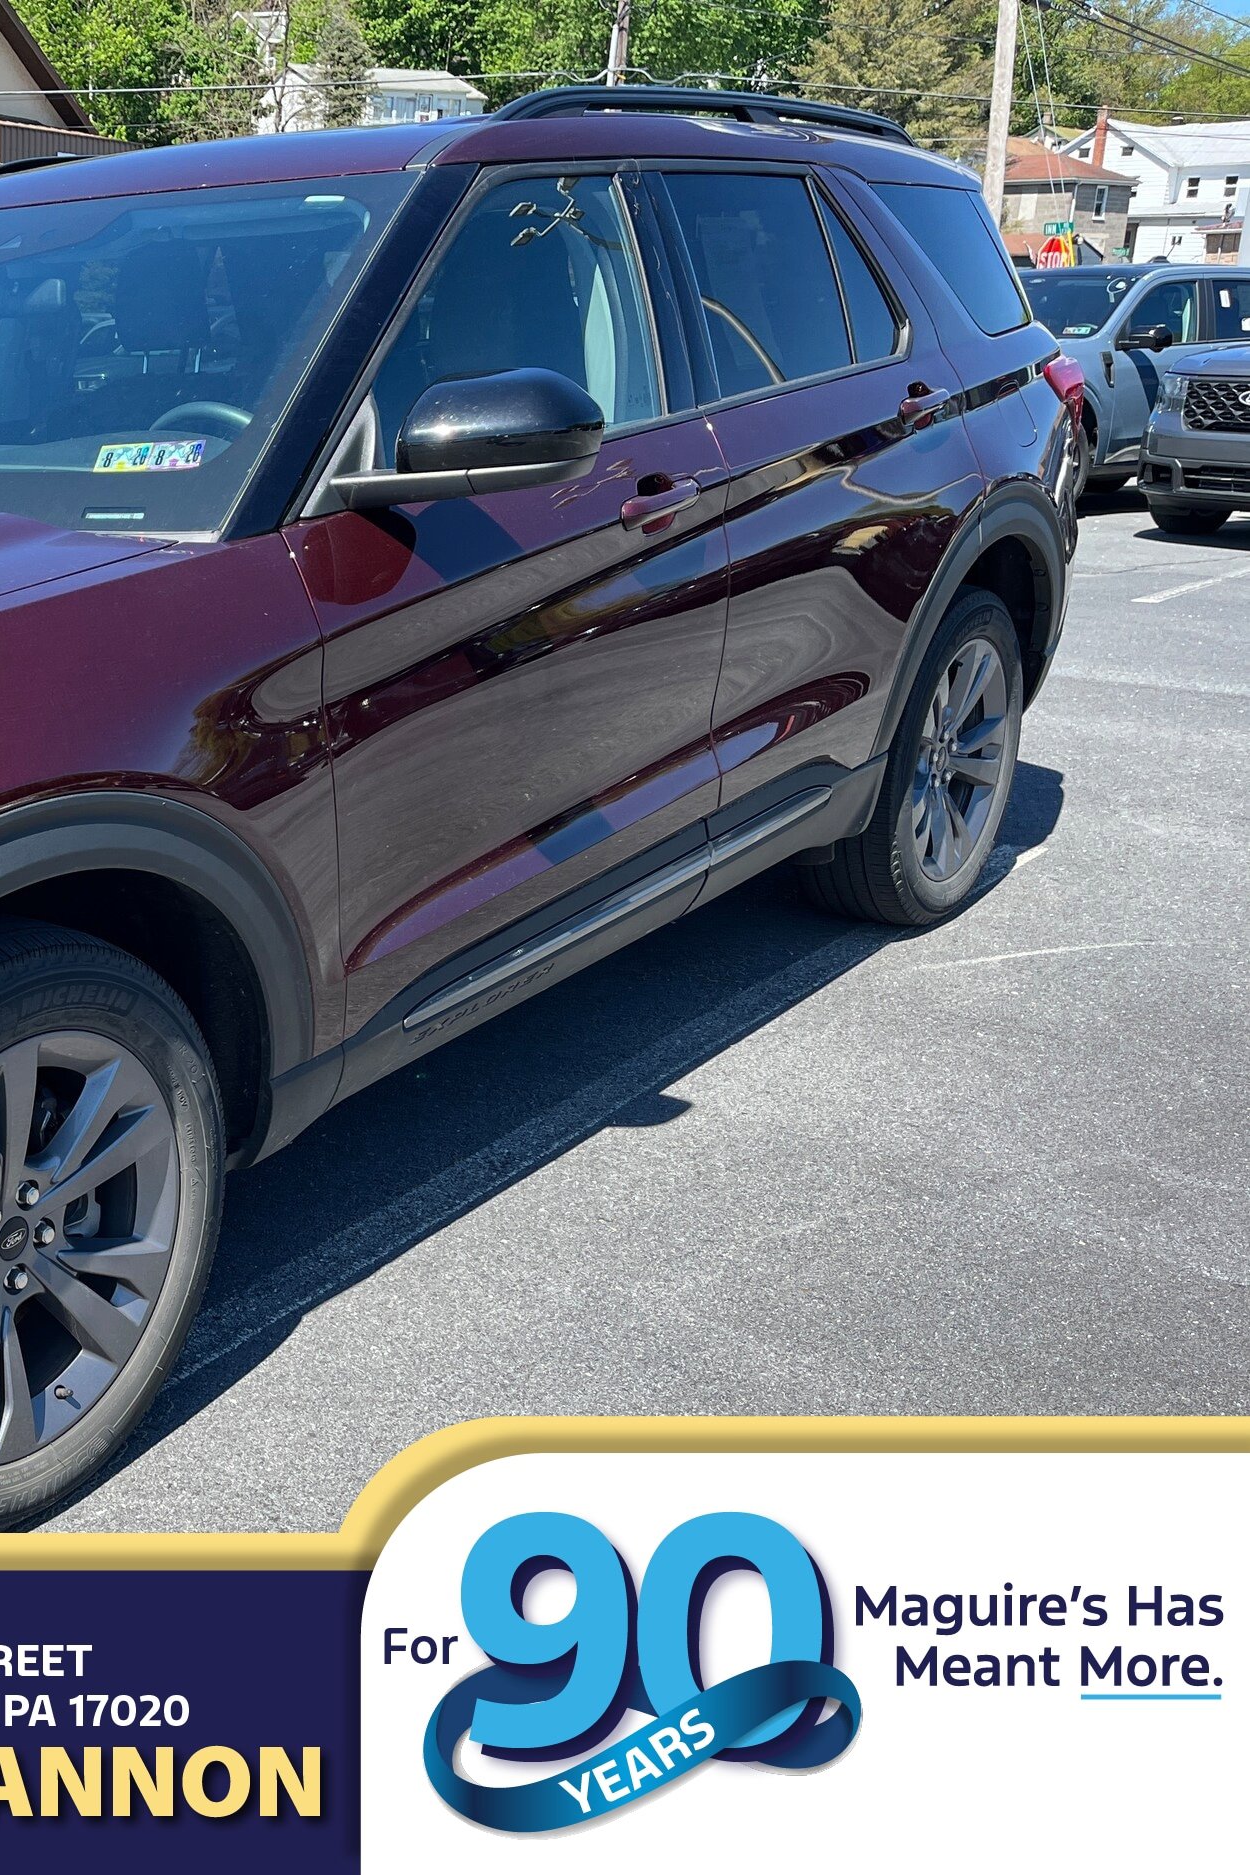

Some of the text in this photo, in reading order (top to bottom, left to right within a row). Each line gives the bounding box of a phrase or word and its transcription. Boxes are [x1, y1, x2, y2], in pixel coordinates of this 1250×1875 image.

[1039, 251, 1069, 269] STOP
[103, 452, 114, 468] 8
[155, 443, 203, 466] 8 26
[21, 984, 134, 1017] MICHELIN
